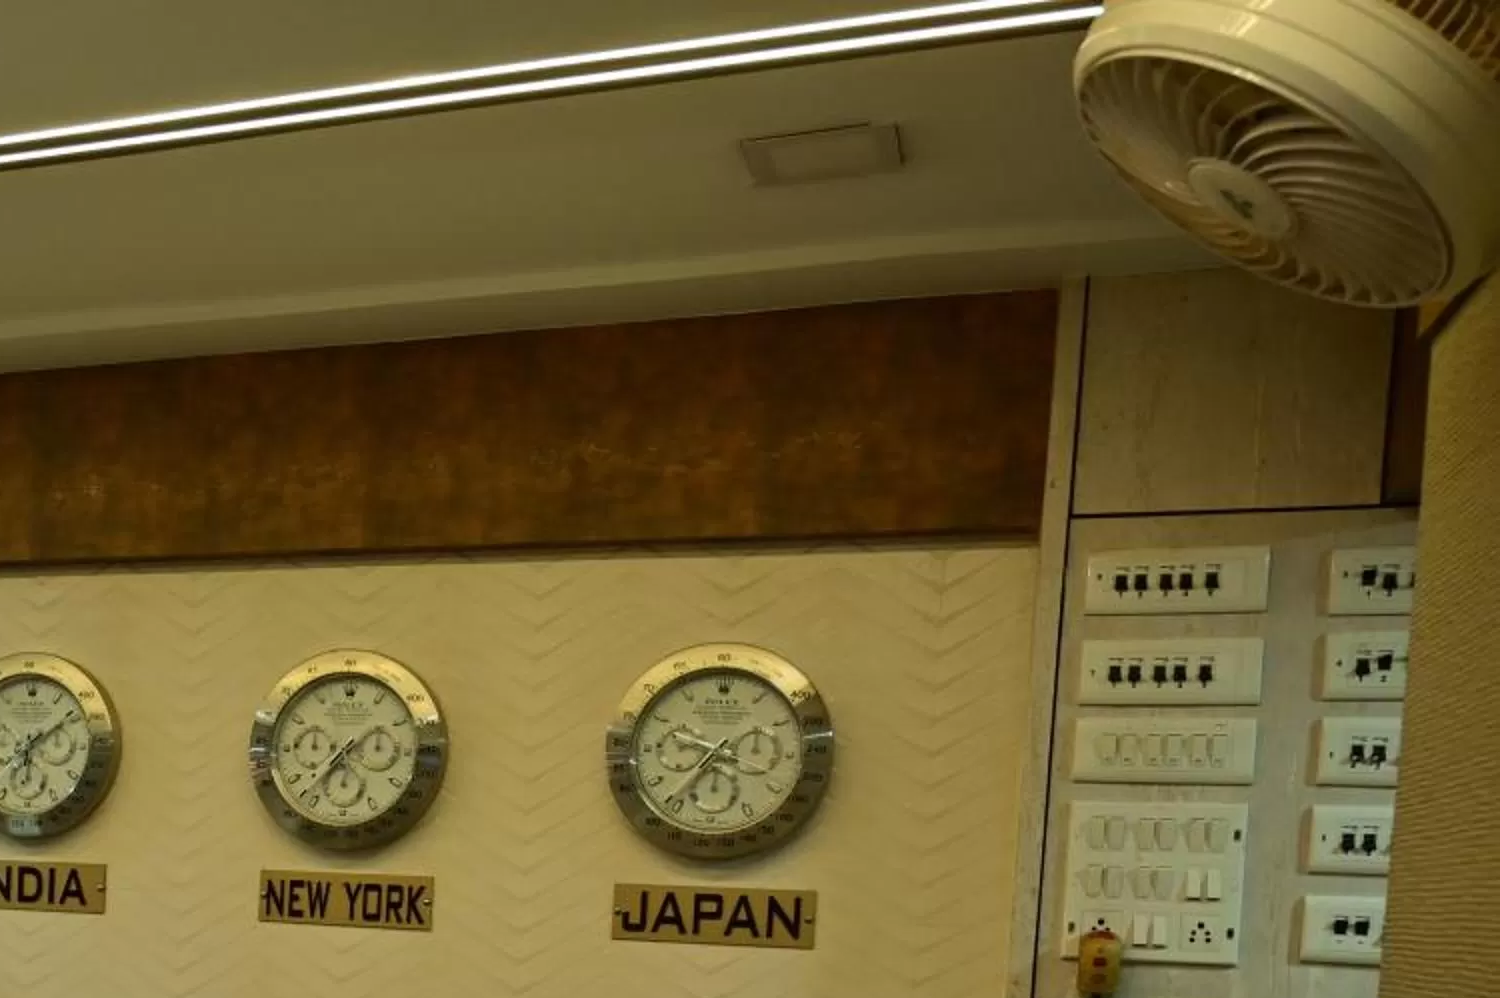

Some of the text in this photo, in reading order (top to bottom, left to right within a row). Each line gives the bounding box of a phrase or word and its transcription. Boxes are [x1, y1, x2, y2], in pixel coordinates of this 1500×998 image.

[265, 879, 426, 925] NEW YORK
[621, 890, 803, 940] JAPAN
